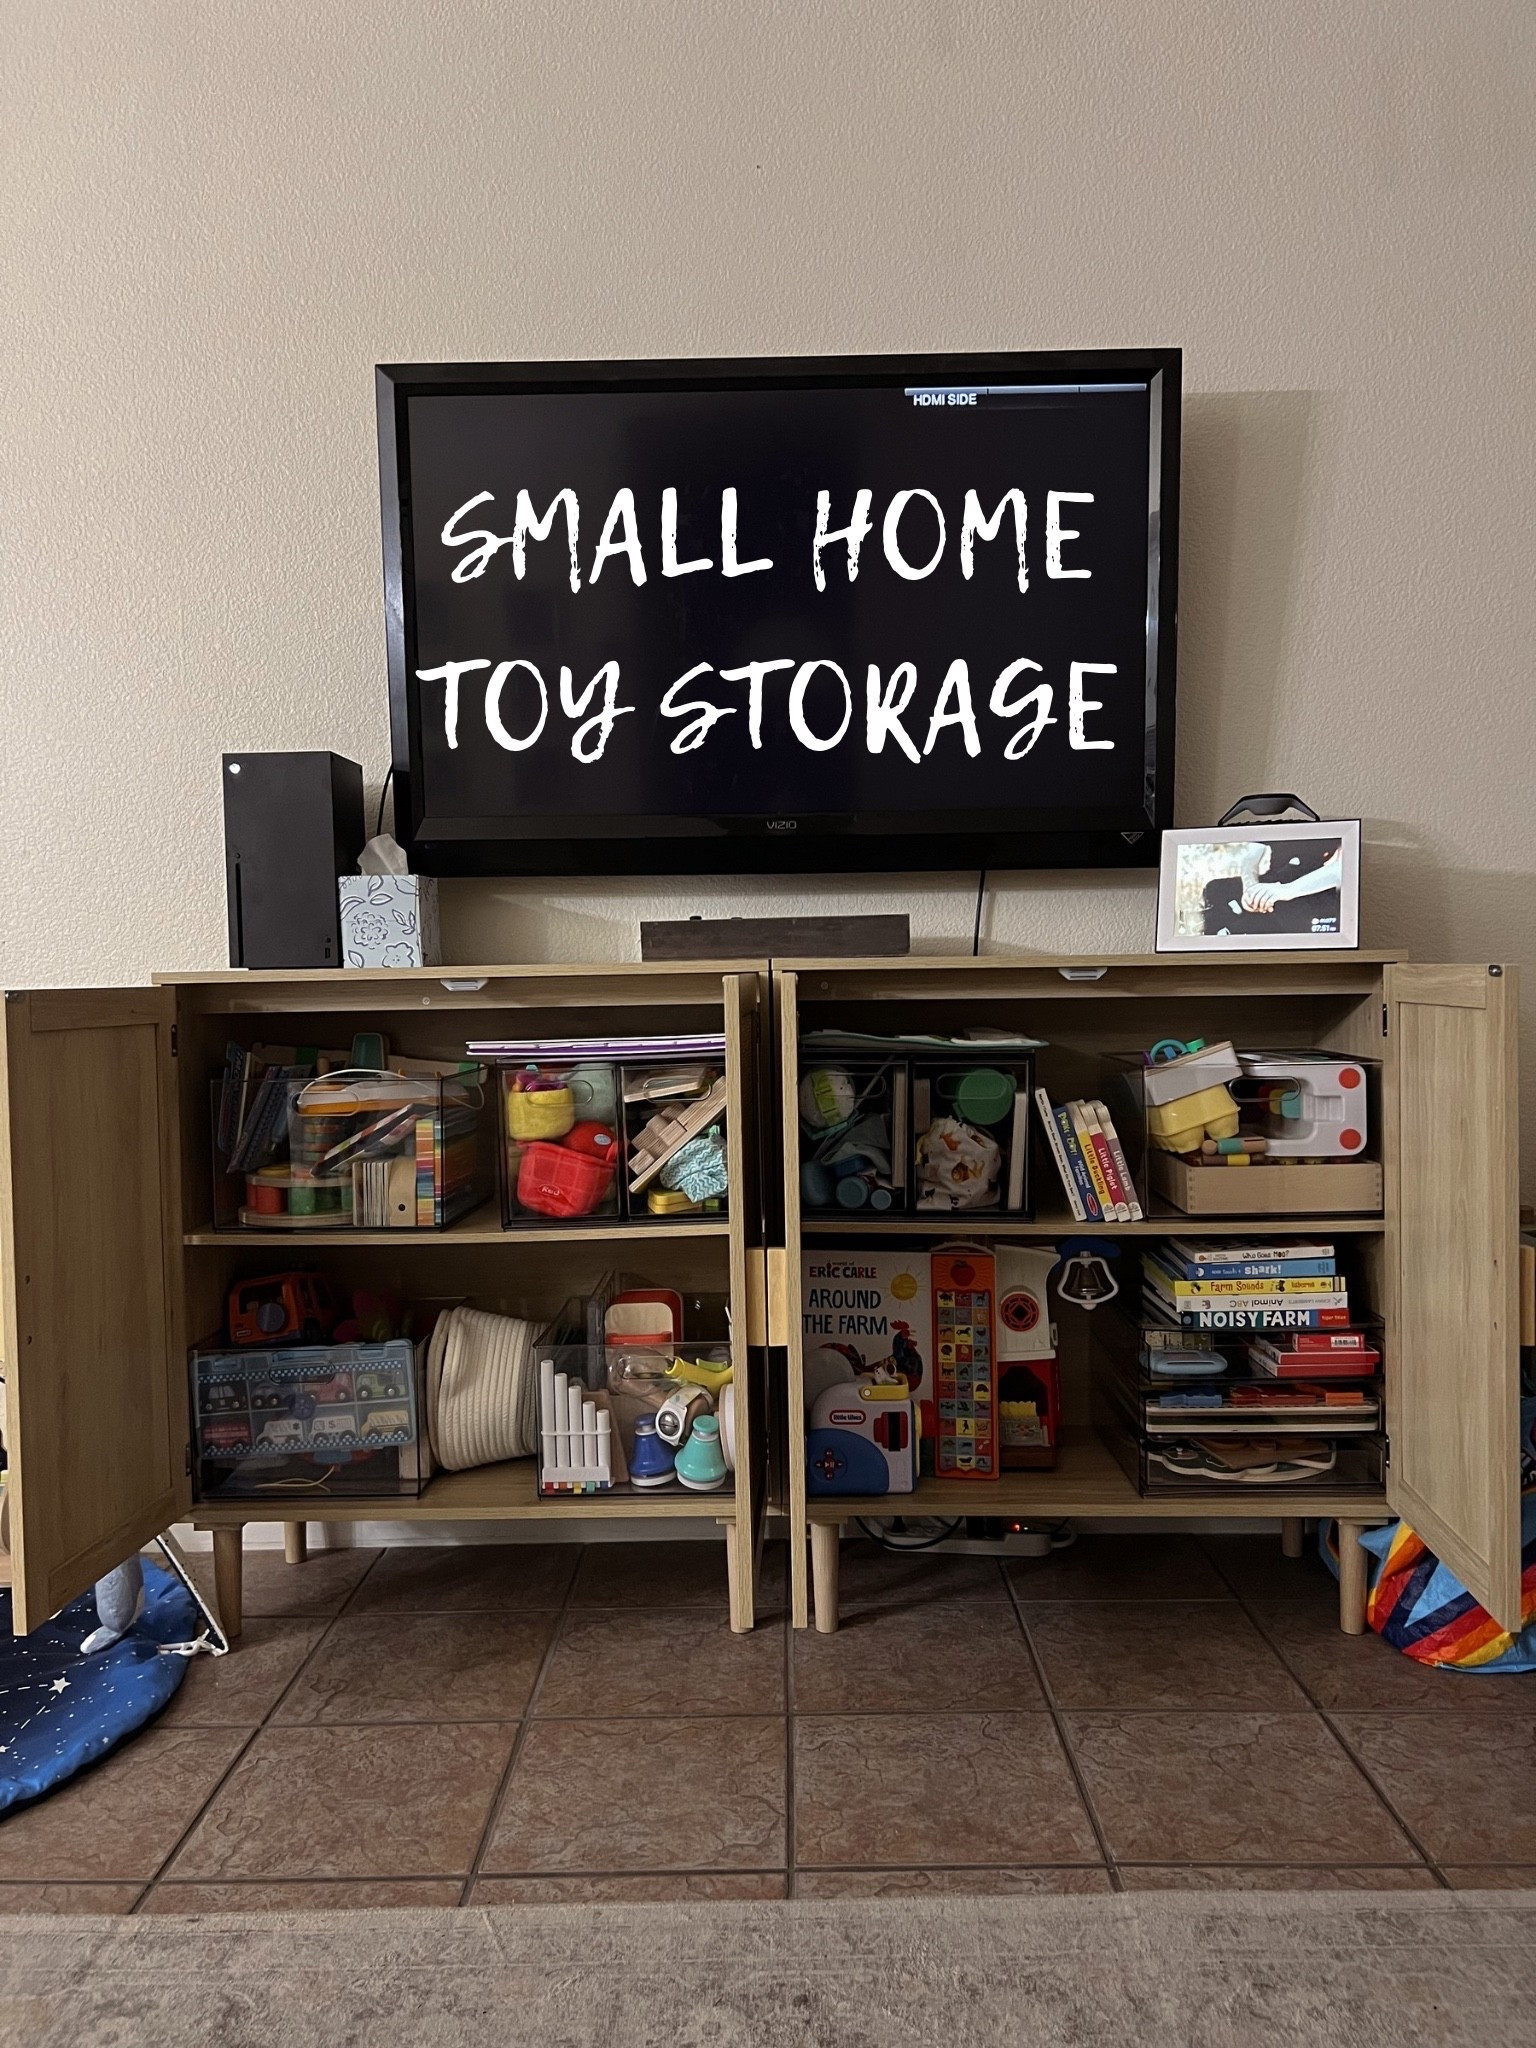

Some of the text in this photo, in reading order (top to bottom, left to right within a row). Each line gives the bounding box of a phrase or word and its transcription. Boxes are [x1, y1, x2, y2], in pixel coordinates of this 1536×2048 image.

[913, 393, 977, 406] HDMI SIDE
[766, 820, 797, 830] VIZIO
[1084, 1143, 1095, 1163] Little
[1091, 1165, 1105, 1195] Duckling
[1098, 1147, 1109, 1169] Little
[1106, 1169, 1118, 1190] Piglet
[1113, 1150, 1125, 1171] Little
[1120, 1172, 1131, 1191] Lamb
[541, 1186, 560, 1197] Red
[1257, 1251, 1271, 1259] Goes
[842, 1266, 877, 1279] CARLE
[1244, 1264, 1282, 1275] shark!
[1210, 1281, 1264, 1293] Farm Sounds
[808, 1289, 882, 1309] AROUND
[1229, 1298, 1284, 1308] Animal ABC
[802, 1314, 888, 1335] THE FARM
[1199, 1310, 1310, 1327] NOISY FARM
